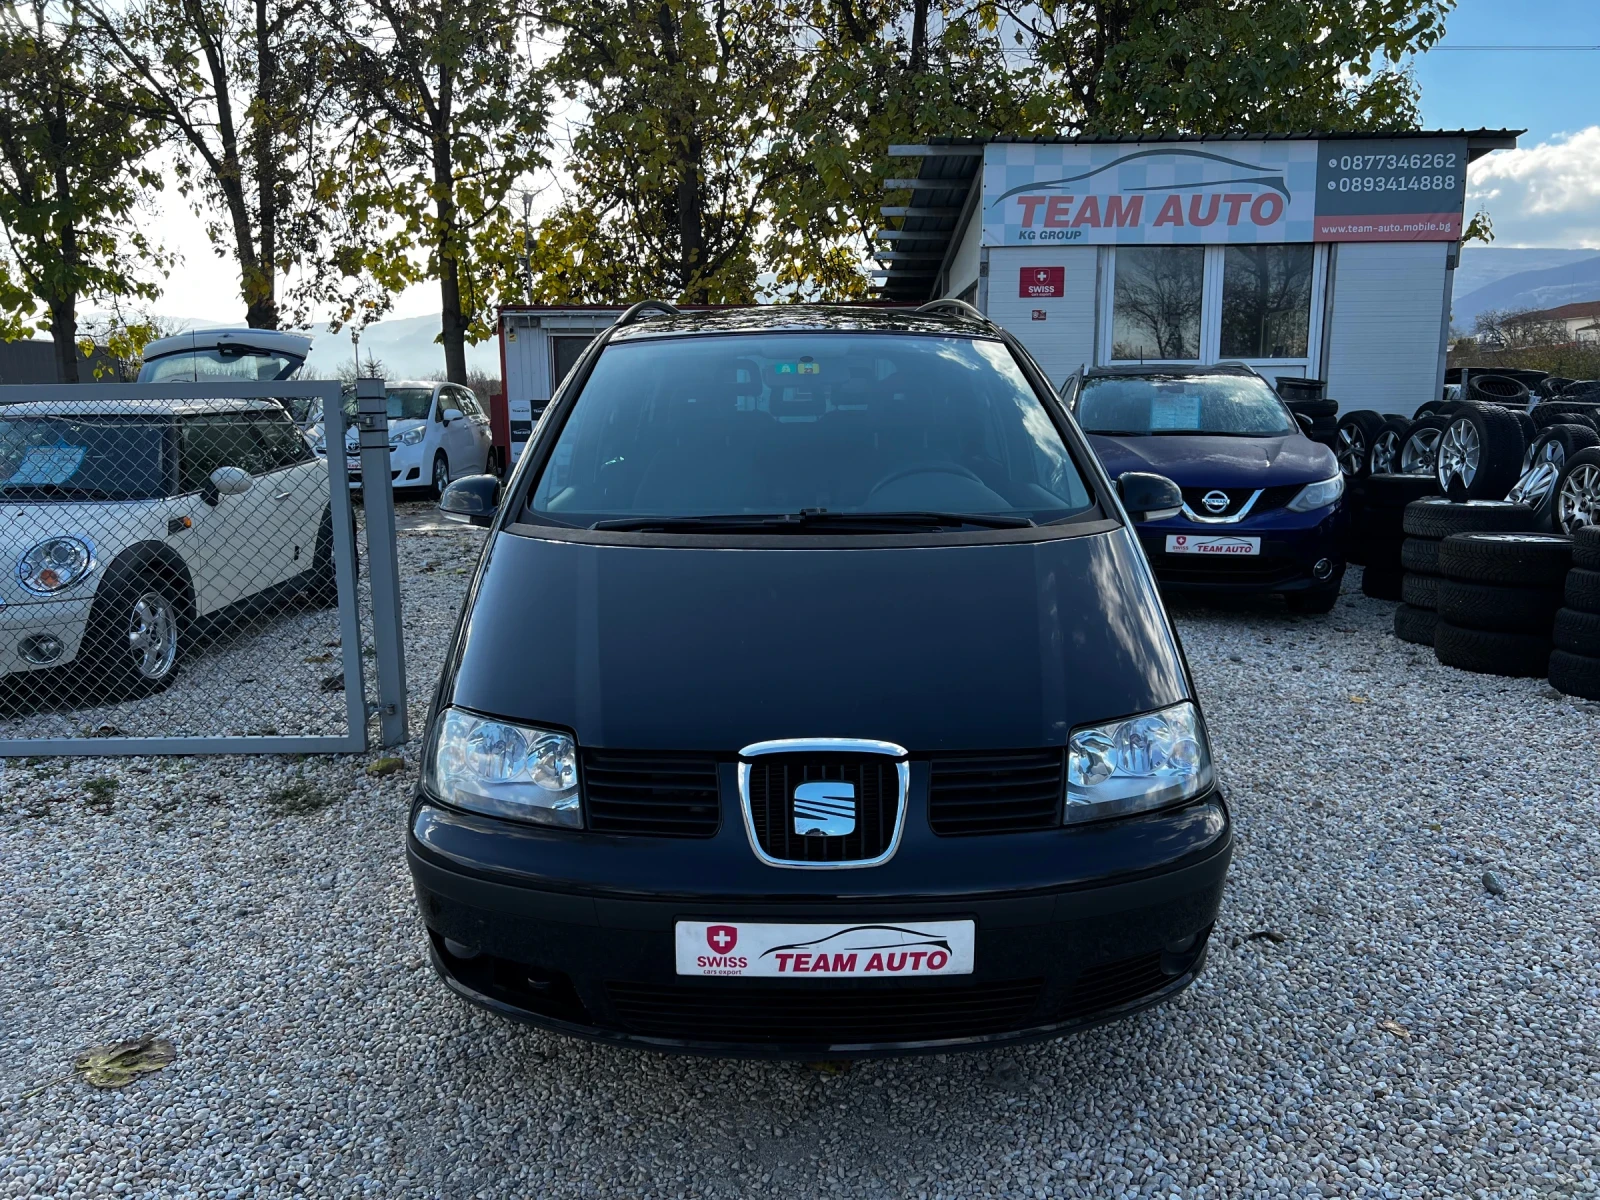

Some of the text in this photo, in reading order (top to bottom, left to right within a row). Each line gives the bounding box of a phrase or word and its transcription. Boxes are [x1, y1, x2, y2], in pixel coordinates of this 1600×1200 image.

[1340, 153, 1456, 171] 0877346262
[1339, 175, 1456, 193] 0893414888
[1017, 193, 1284, 228] TEAM AUTO
[1321, 221, 1451, 234] www.team-auto.mobile.bg
[1018, 230, 1082, 240] KG GROUP
[1028, 285, 1055, 293] SWISS
[1197, 545, 1223, 553] TEAM
[697, 955, 748, 968] SWISS
[775, 950, 948, 972] TEAM AUTO
